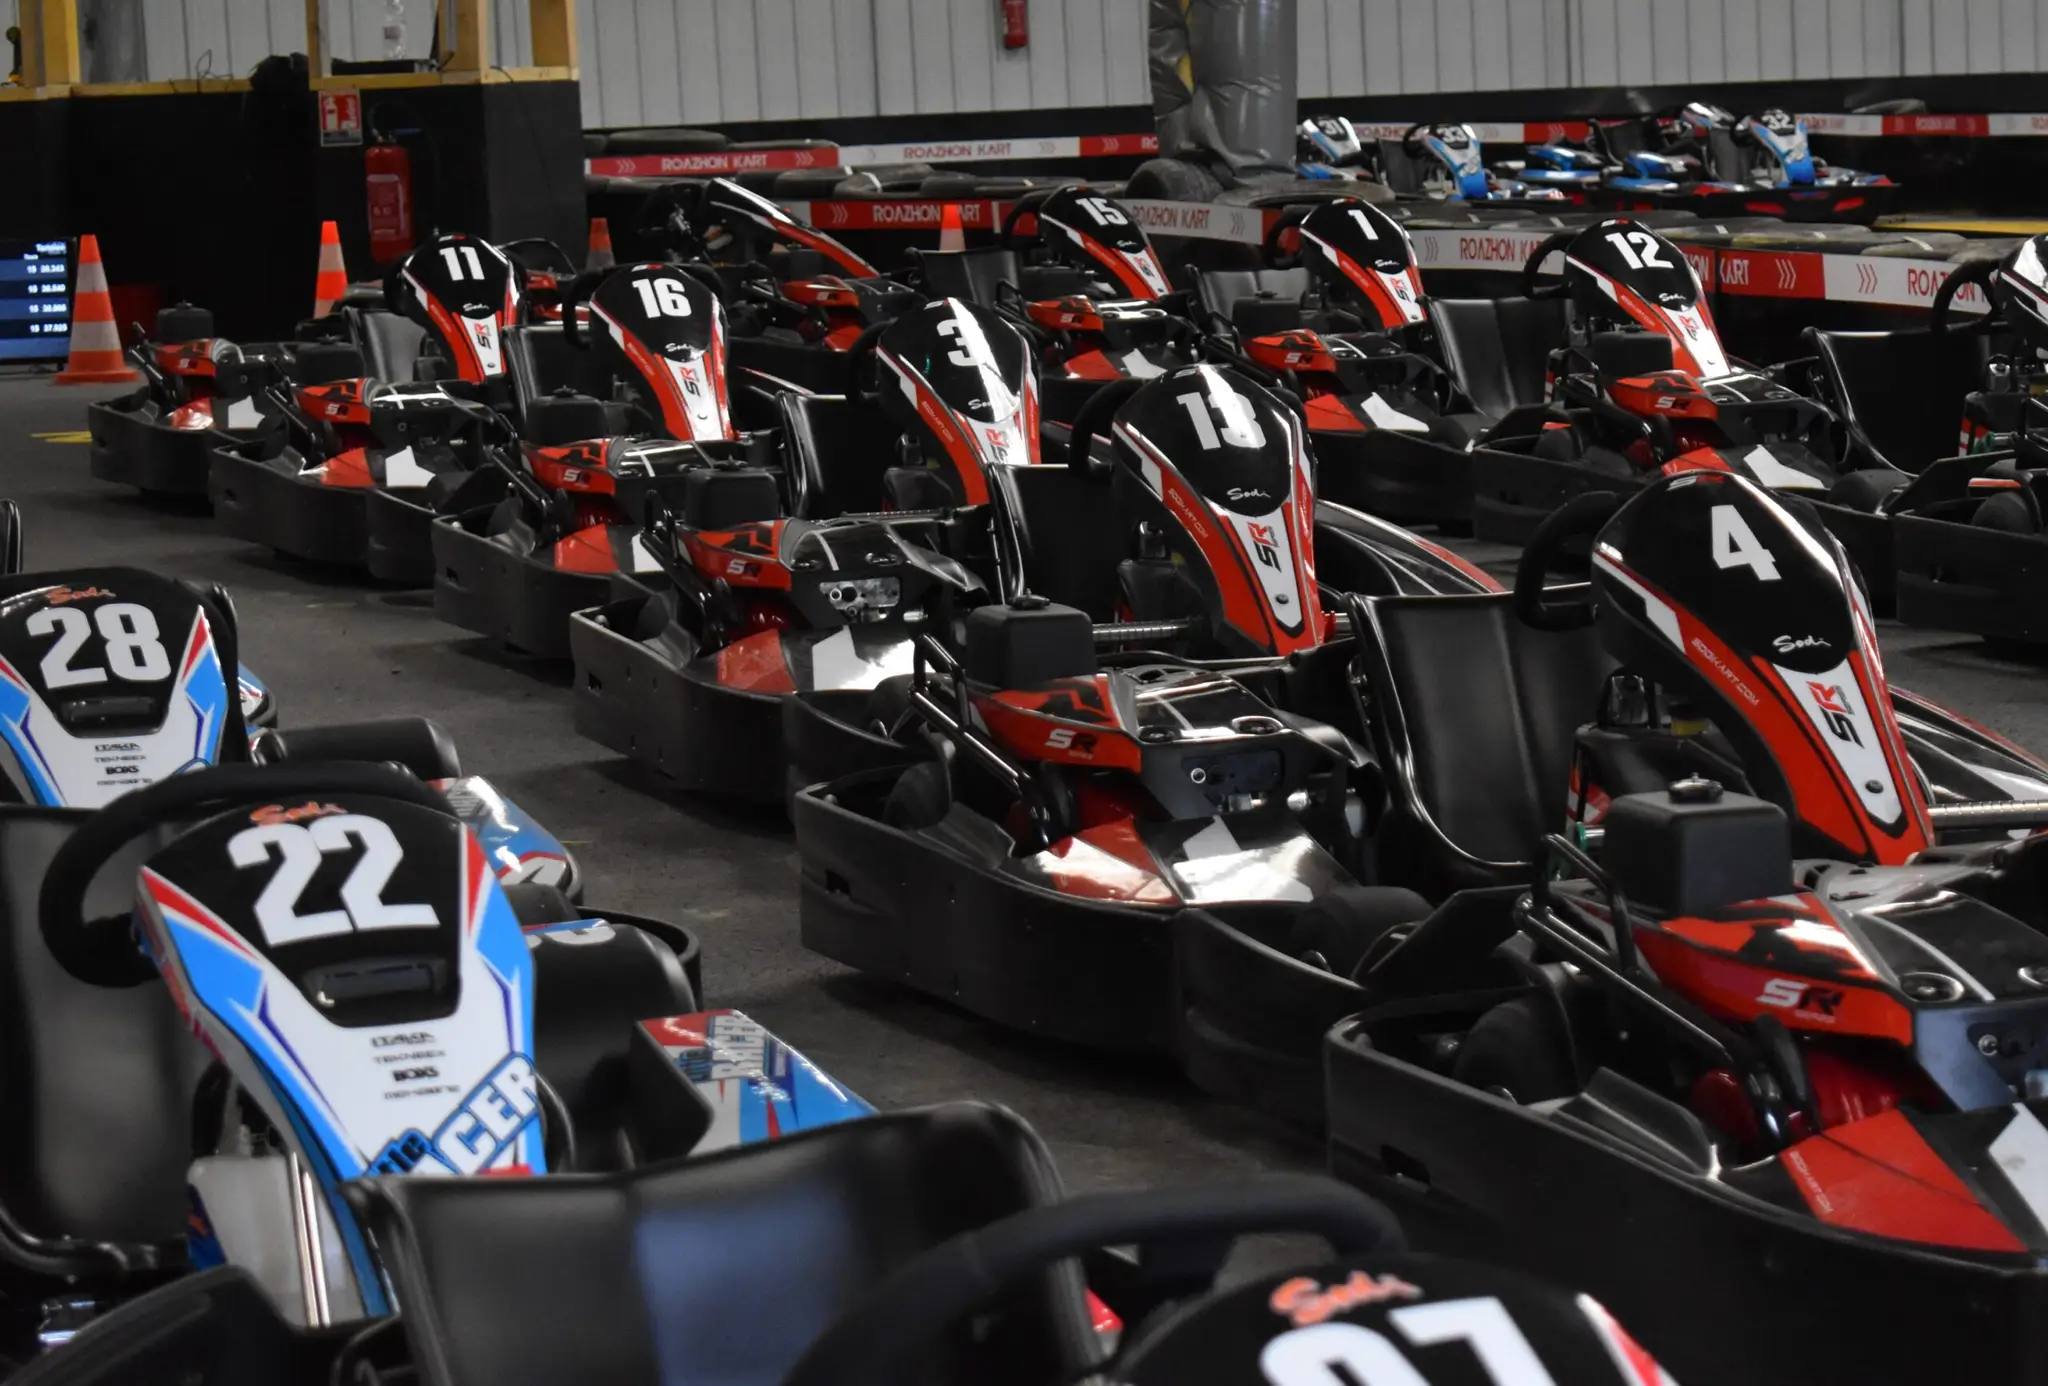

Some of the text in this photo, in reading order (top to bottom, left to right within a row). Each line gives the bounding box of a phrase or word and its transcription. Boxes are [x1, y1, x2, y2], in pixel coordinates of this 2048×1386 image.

[661, 153, 768, 171] ROAZHON KART
[902, 141, 1012, 160] ROAZHON KART
[872, 204, 941, 222] ROAZHON
[1075, 197, 1128, 226] 15
[1181, 209, 1210, 230] KART
[1347, 209, 1379, 241] 1
[439, 246, 485, 281] 11
[1460, 238, 1515, 261] ROAZHON
[1604, 231, 1674, 269] 12
[631, 277, 692, 319] 16
[936, 318, 982, 367] 3
[1176, 391, 1268, 450] 13
[1711, 504, 1782, 581] 4
[26, 602, 172, 689] 28
[1772, 634, 1832, 654] Sodi
[226, 814, 441, 949] 22
